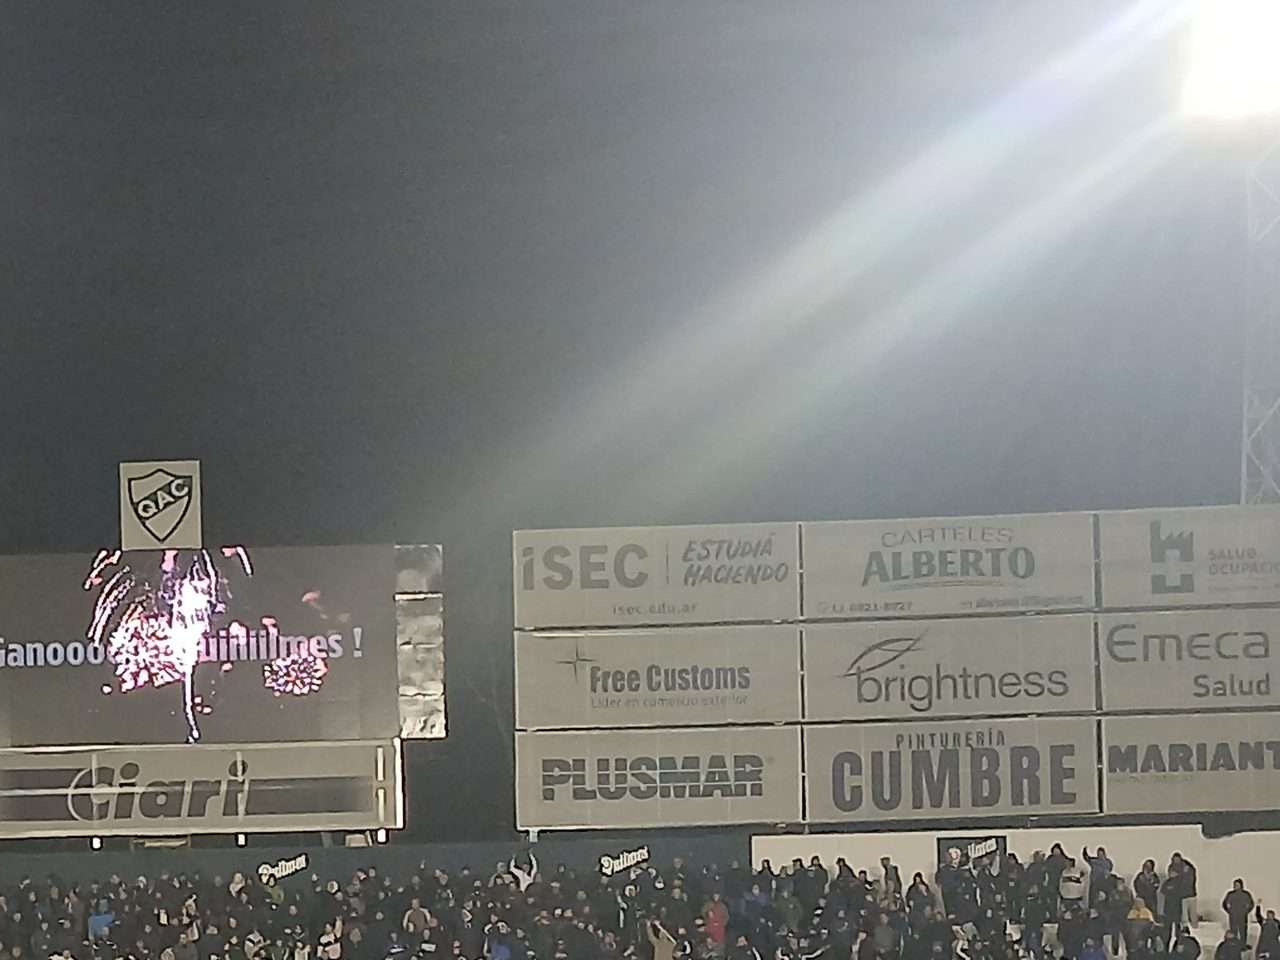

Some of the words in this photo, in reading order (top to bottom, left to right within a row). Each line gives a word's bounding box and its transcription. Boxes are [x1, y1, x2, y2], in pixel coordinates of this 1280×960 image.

[138, 478, 189, 518] QAC
[881, 527, 1014, 548] CARTELES
[683, 562, 789, 587] HACIENDO
[861, 546, 1036, 587] ALBERTO
[1106, 623, 1271, 664] Emeca
[590, 665, 641, 693] Free
[646, 663, 751, 692] Customs
[856, 664, 1069, 712] brightness
[1192, 673, 1272, 699] Salud
[541, 754, 765, 801] PLUSMAR
[832, 743, 1078, 813] CUMBRE
